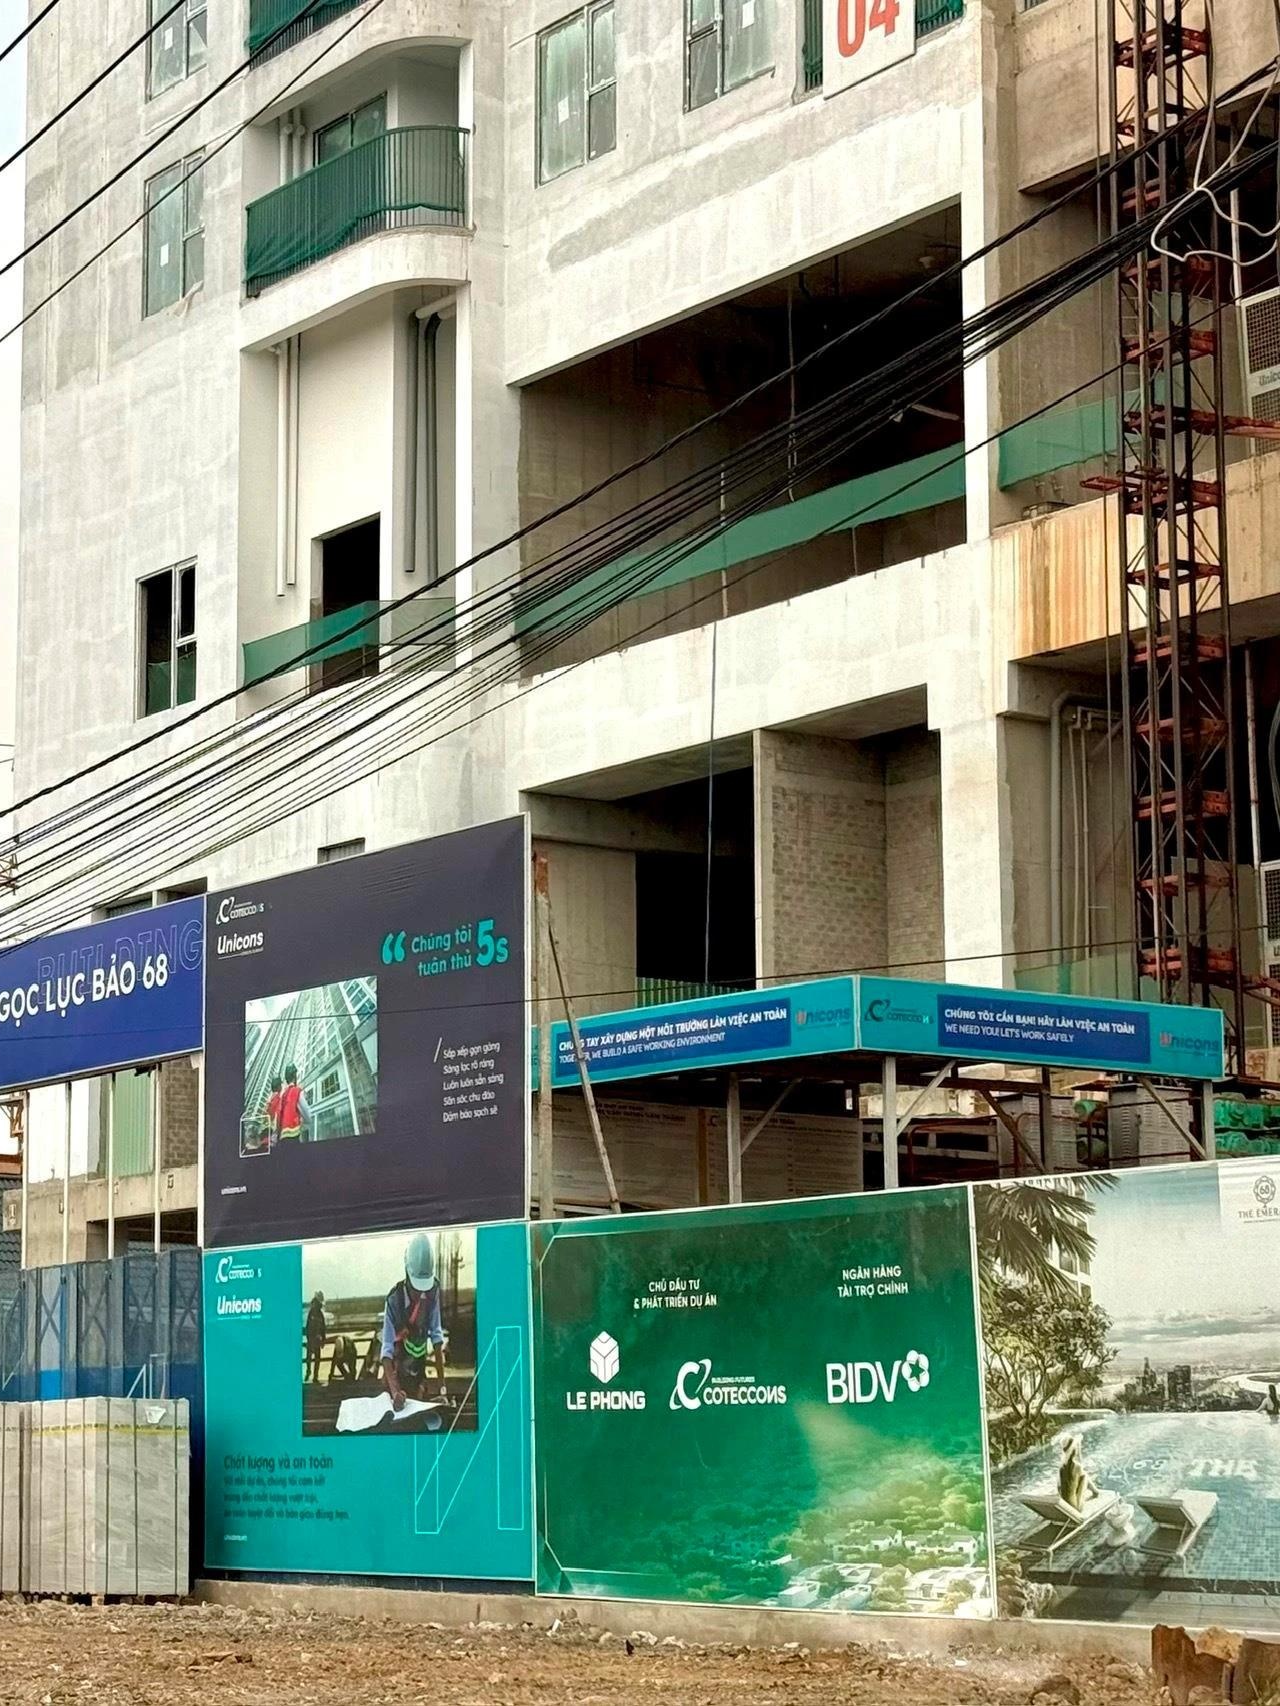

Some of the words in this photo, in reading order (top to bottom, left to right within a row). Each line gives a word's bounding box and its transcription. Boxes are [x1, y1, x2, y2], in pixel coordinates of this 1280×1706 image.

[837, 0, 900, 58] 04
[217, 931, 264, 954] Unicons
[411, 932, 451, 953] Chúng
[455, 924, 472, 944] tôi
[418, 957, 447, 977] tuân
[451, 949, 472, 970] thủ
[46, 973, 85, 1017] LỤC
[92, 954, 136, 1001] BẢO
[142, 953, 168, 990] 68
[559, 1039, 585, 1051] CHUG
[586, 1037, 599, 1048] TAY
[600, 1033, 614, 1045] XÂY
[616, 1031, 638, 1045] DỰNG
[639, 1027, 655, 1040] MỘT
[657, 1023, 673, 1036] MÔI
[675, 1018, 708, 1034] TRƯỜNG
[710, 1014, 727, 1028] LÀM
[728, 1012, 748, 1028] VIỆC
[749, 1010, 762, 1023] AN
[763, 1006, 787, 1021] TOÀN
[944, 1007, 976, 1020] CHÚNG
[977, 1009, 994, 1021] TÔI
[996, 1009, 1014, 1023] CẦN
[1015, 1015, 1036, 1027] BẠN!
[1037, 1015, 1054, 1027] HÃY
[1055, 1015, 1074, 1028] LÀM
[1075, 1018, 1096, 1033] VIỆC
[1097, 1022, 1110, 1032] AN
[1111, 1021, 1136, 1035] TOÀN
[944, 1023, 958, 1033] WE
[959, 1025, 980, 1035] NEED
[981, 1027, 999, 1037] YOU!
[1000, 1028, 1020, 1038] LET'S
[1021, 1030, 1046, 1041] WORK
[1047, 1032, 1073, 1043] SAFELY
[592, 1051, 603, 1059] WE
[603, 1048, 621, 1058] BUILD
[622, 1046, 627, 1055] A
[628, 1043, 643, 1054] SAFE
[643, 1038, 676, 1052] WORKING
[676, 1032, 726, 1048] ENVIRONMENT
[1257, 1208, 1280, 1218] EMER
[842, 1265, 870, 1281] NGÂN
[872, 1264, 902, 1279] HÀNG
[648, 1277, 667, 1293] CHỦ
[668, 1277, 687, 1292] ĐẦU
[688, 1278, 700, 1290] TƯ
[837, 1284, 852, 1298] TÀI
[854, 1283, 875, 1299] TRỢ
[877, 1281, 909, 1295] CHÍNH
[217, 1294, 262, 1315] Unicons
[633, 1298, 640, 1309] &
[641, 1295, 663, 1309] PHÁT
[664, 1293, 689, 1308] TRIỂN
[690, 1295, 703, 1310] DỰ
[704, 1293, 717, 1306] ÁN
[826, 1360, 902, 1404] BIDV
[566, 1391, 587, 1410] LE
[590, 1390, 646, 1410] PHONG
